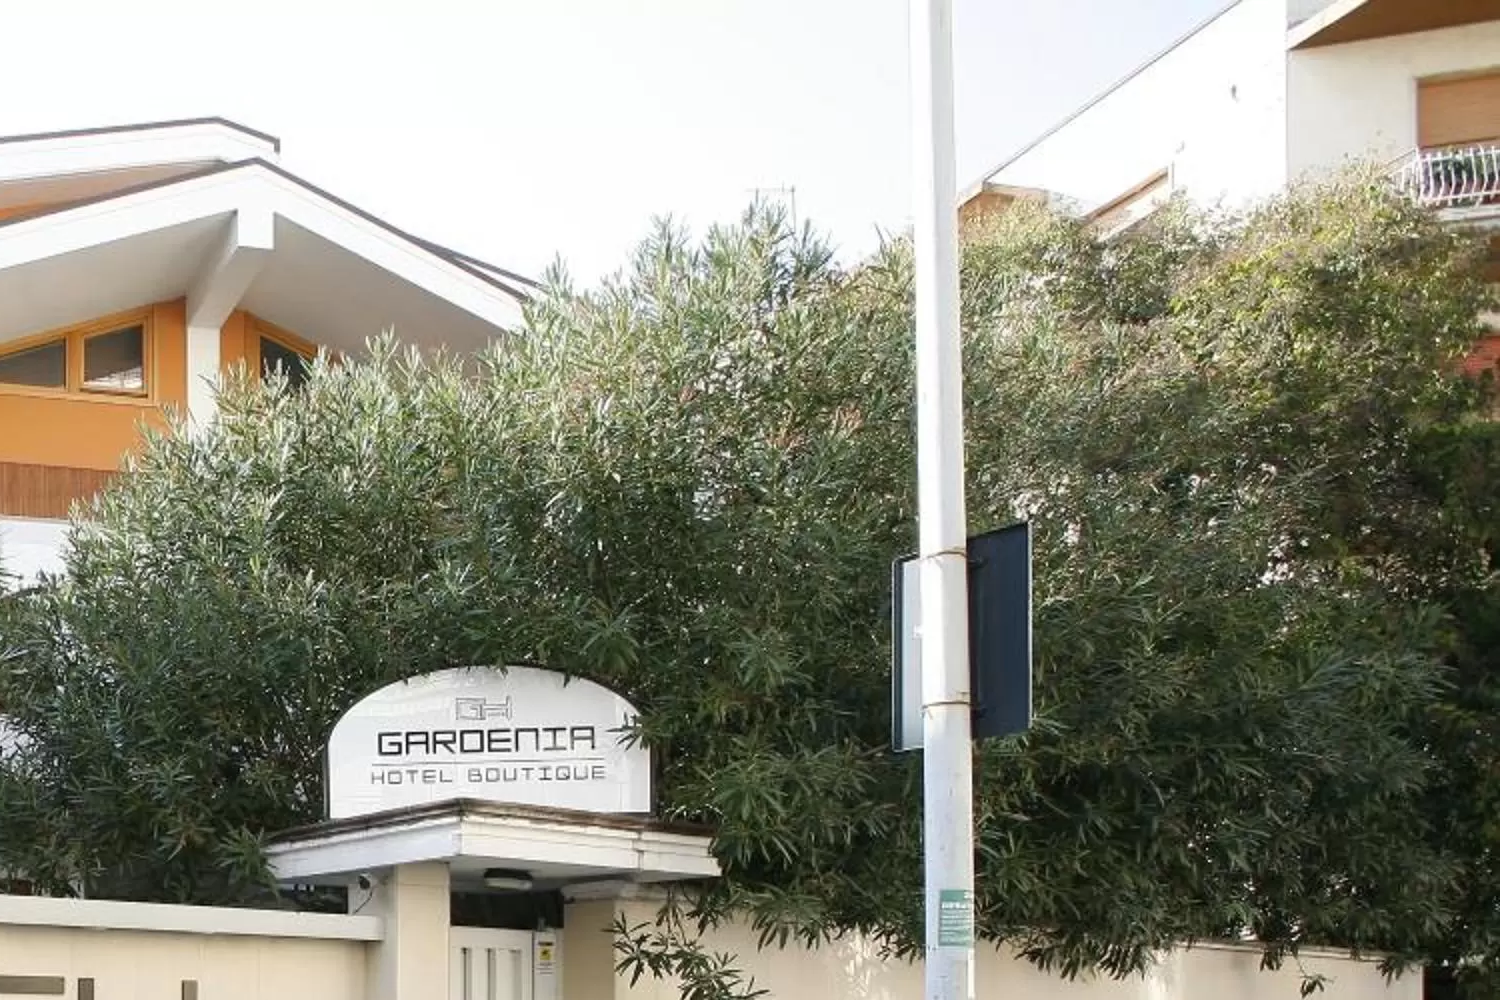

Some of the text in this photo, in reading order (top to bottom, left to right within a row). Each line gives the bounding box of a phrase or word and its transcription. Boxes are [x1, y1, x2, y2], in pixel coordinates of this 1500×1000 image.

[377, 726, 596, 756] GARDENIA
[372, 766, 605, 785] HOTEL BOUTIQUE
